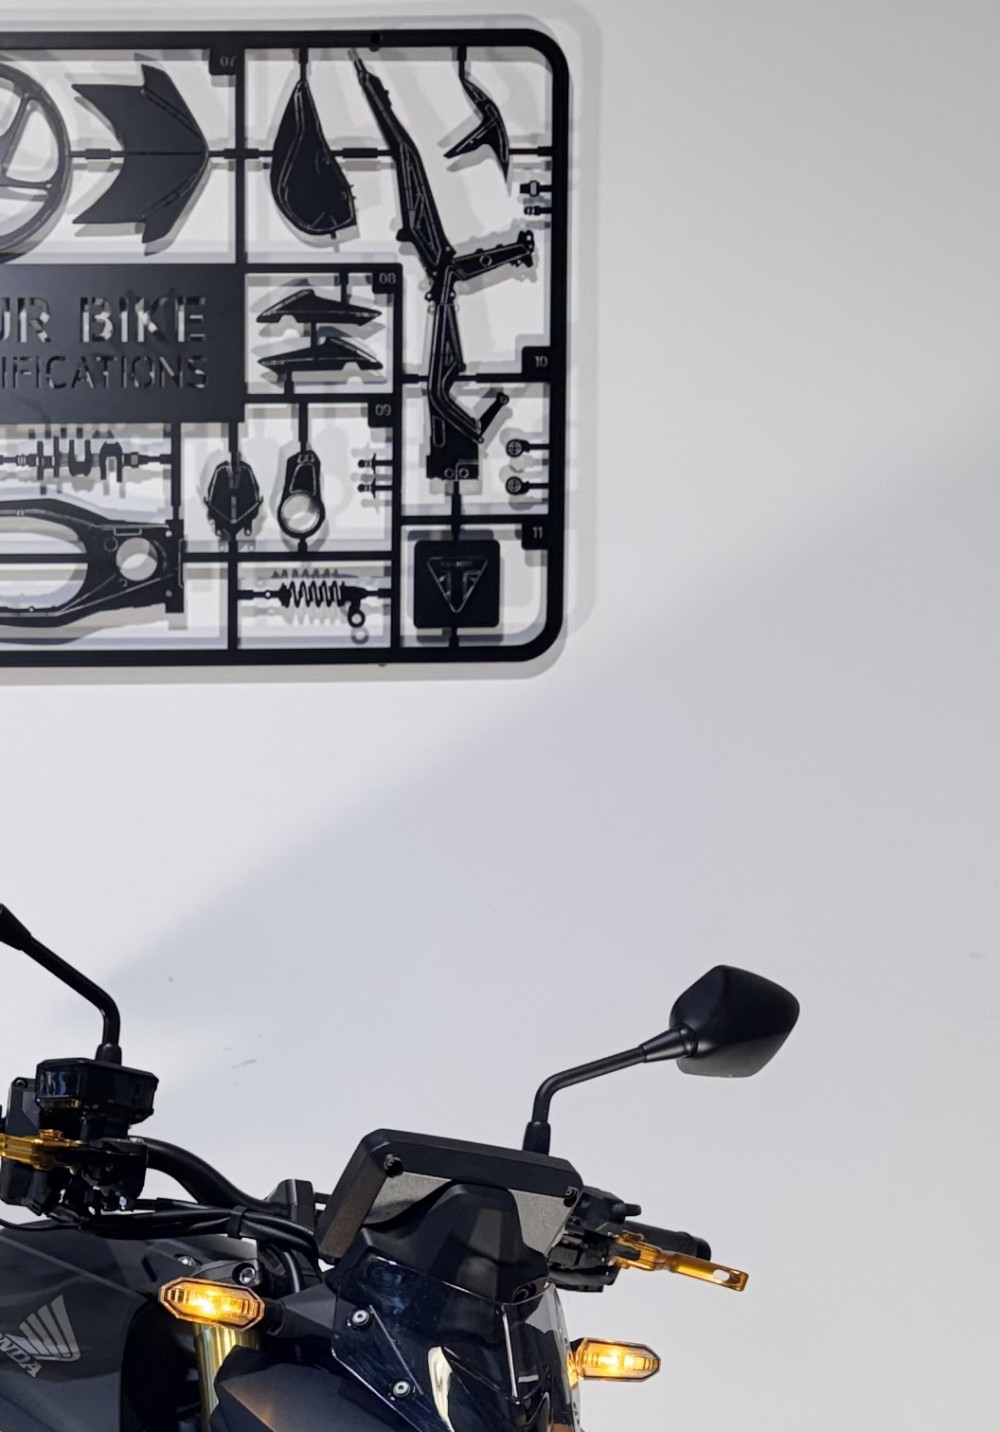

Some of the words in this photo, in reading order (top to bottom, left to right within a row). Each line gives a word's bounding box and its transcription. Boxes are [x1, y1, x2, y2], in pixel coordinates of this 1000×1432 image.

[80, 296, 206, 343] BIKE
[534, 355, 548, 368] 10
[375, 403, 392, 417] 09
